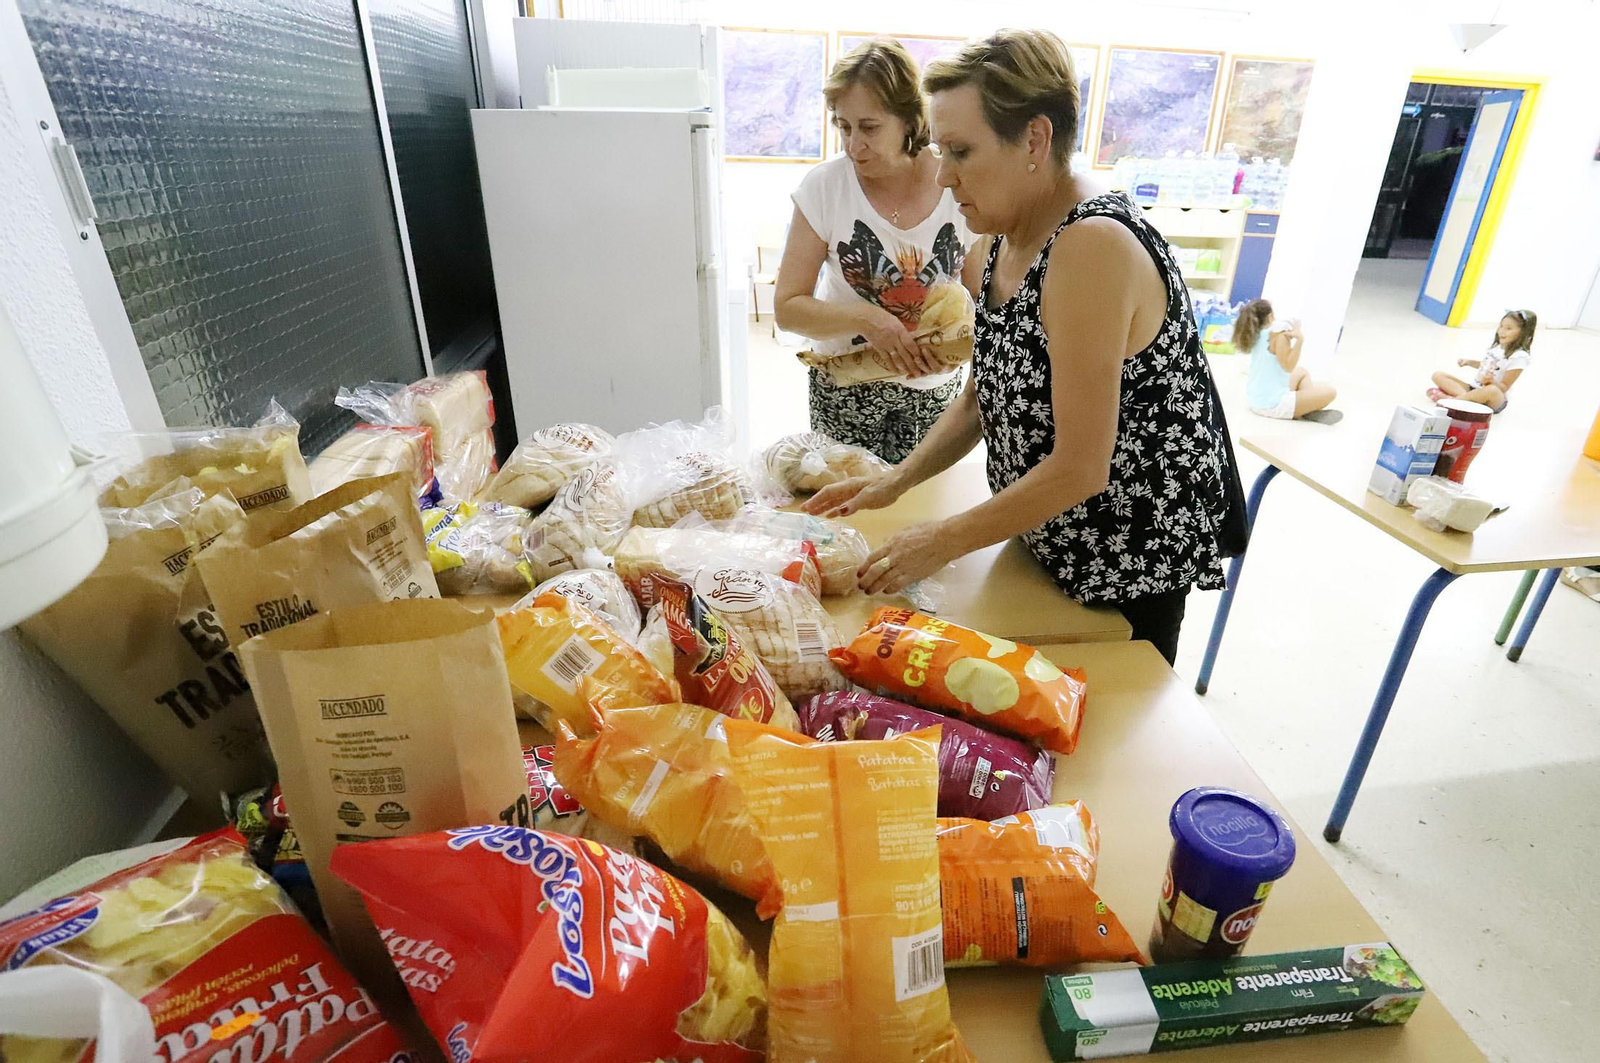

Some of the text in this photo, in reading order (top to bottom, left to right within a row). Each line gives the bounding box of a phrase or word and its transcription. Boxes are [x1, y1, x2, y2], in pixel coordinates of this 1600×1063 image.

[255, 593, 299, 620] ESTILO
[240, 599, 318, 639] TRADICIONAL
[320, 697, 385, 717] HACENDADO
[857, 752, 915, 769] Patatas
[368, 776, 385, 785] 500
[369, 784, 386, 793] 500
[388, 783, 403, 792] 100
[1208, 815, 1260, 837] nocilla
[551, 883, 595, 1000] Los
[1152, 964, 1354, 997] Transparente Aderente
[1073, 987, 1092, 1001] 80
[1179, 987, 1314, 1012] Film Película
[1242, 1010, 1354, 1034] Transparente
[1081, 1037, 1099, 1047] 80
[1157, 1023, 1240, 1043] Aderente
